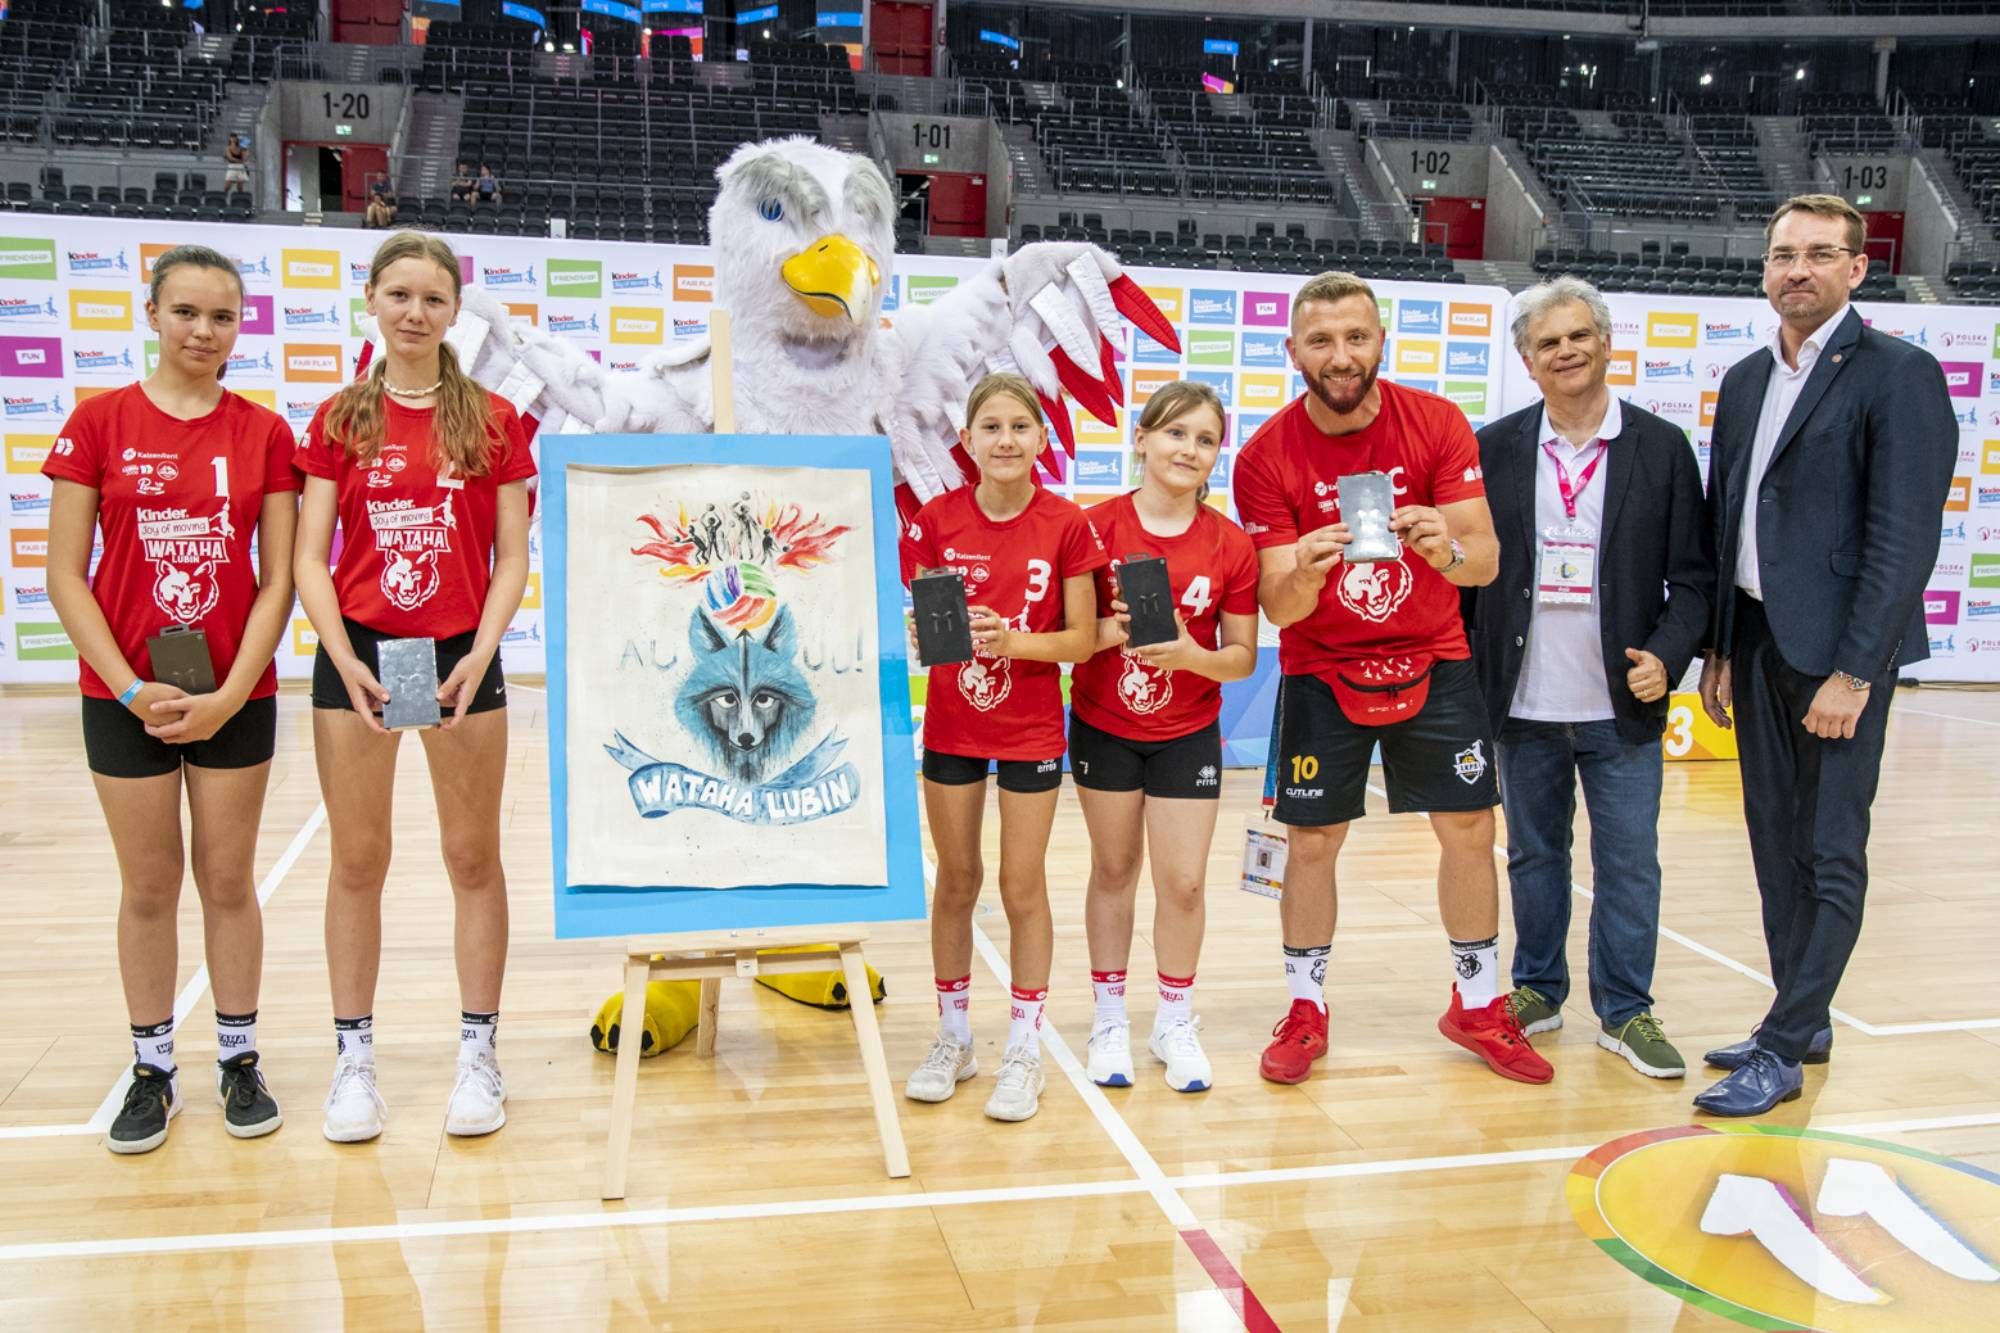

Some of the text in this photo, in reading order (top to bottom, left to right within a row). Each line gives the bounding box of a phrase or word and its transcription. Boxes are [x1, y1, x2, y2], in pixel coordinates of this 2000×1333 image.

[322, 91, 370, 119] 1-20
[912, 123, 951, 149] 1-01
[1410, 150, 1451, 175] 1-02
[1844, 166, 1887, 190] 1-03
[21, 352, 40, 360] FUN
[210, 456, 229, 497] 1
[160, 524, 171, 534] of
[172, 523, 206, 535] moving
[400, 511, 431, 523] moving
[147, 540, 223, 559] WATAHA
[379, 530, 445, 548] WATAHA
[171, 555, 200, 563] LUBIN
[1024, 559, 1052, 602] 3
[1181, 575, 1213, 617] 4
[1665, 706, 1694, 757] 3
[1292, 755, 1319, 784] 10
[637, 773, 852, 819] WATAHA LUBIN
